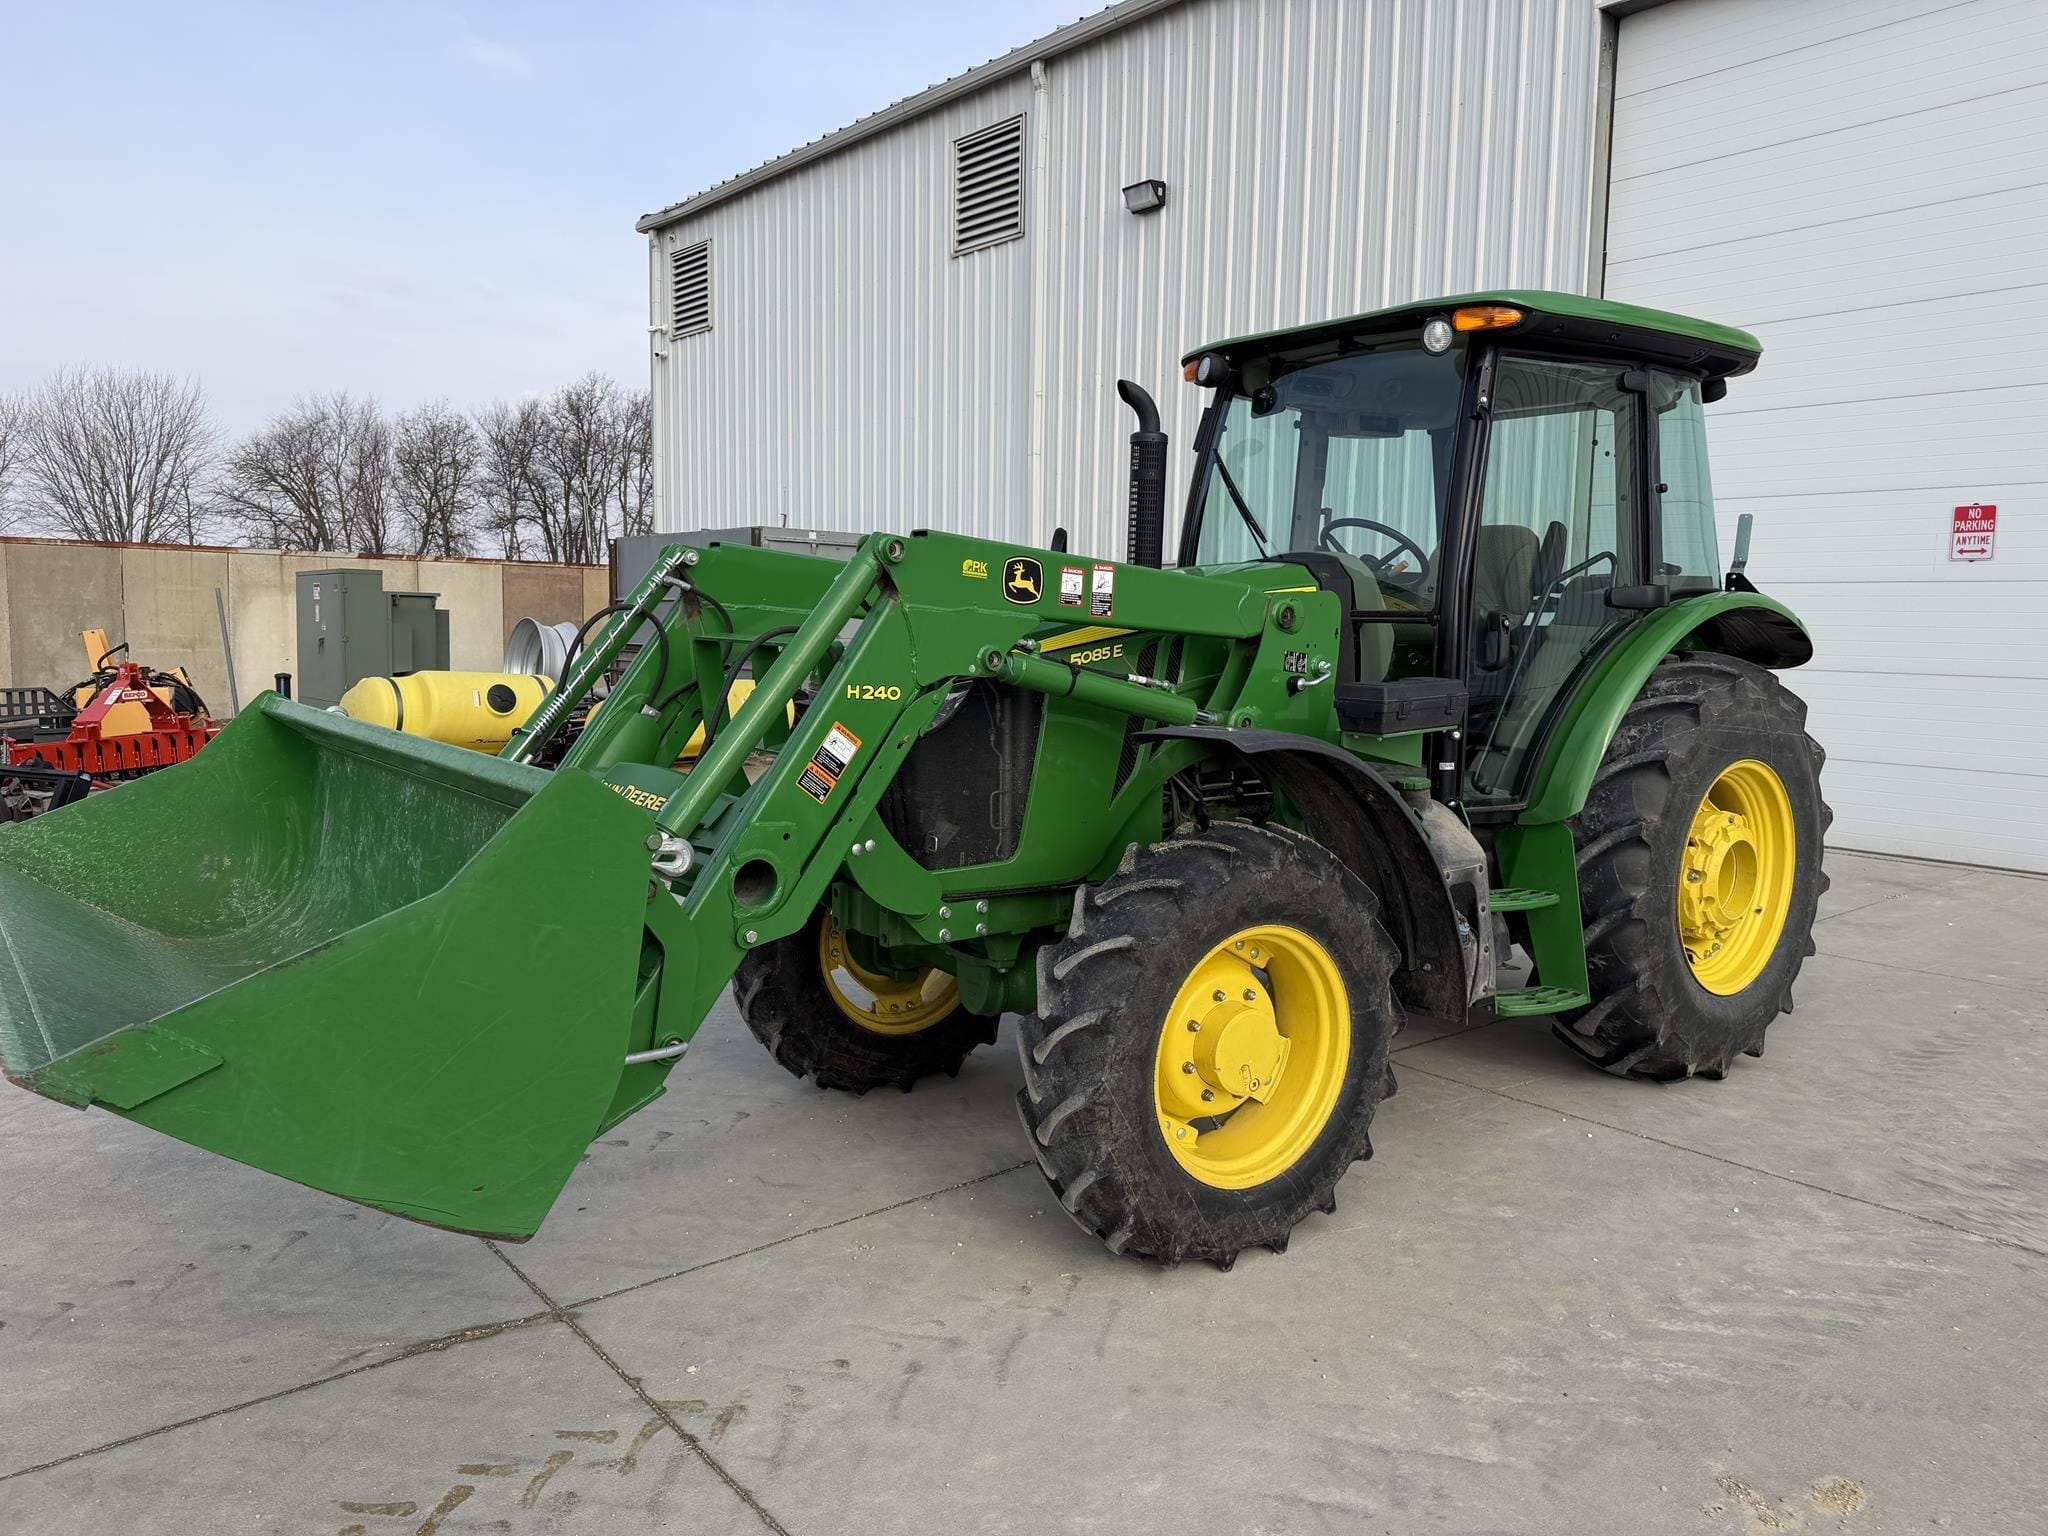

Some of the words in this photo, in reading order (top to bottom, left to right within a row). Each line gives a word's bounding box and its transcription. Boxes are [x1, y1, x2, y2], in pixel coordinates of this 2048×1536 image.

[1968, 508, 1981, 519] NO
[1954, 520, 1994, 531] PARKING
[1955, 535, 1991, 545] ANYTIME
[621, 784, 667, 812] DEERE
